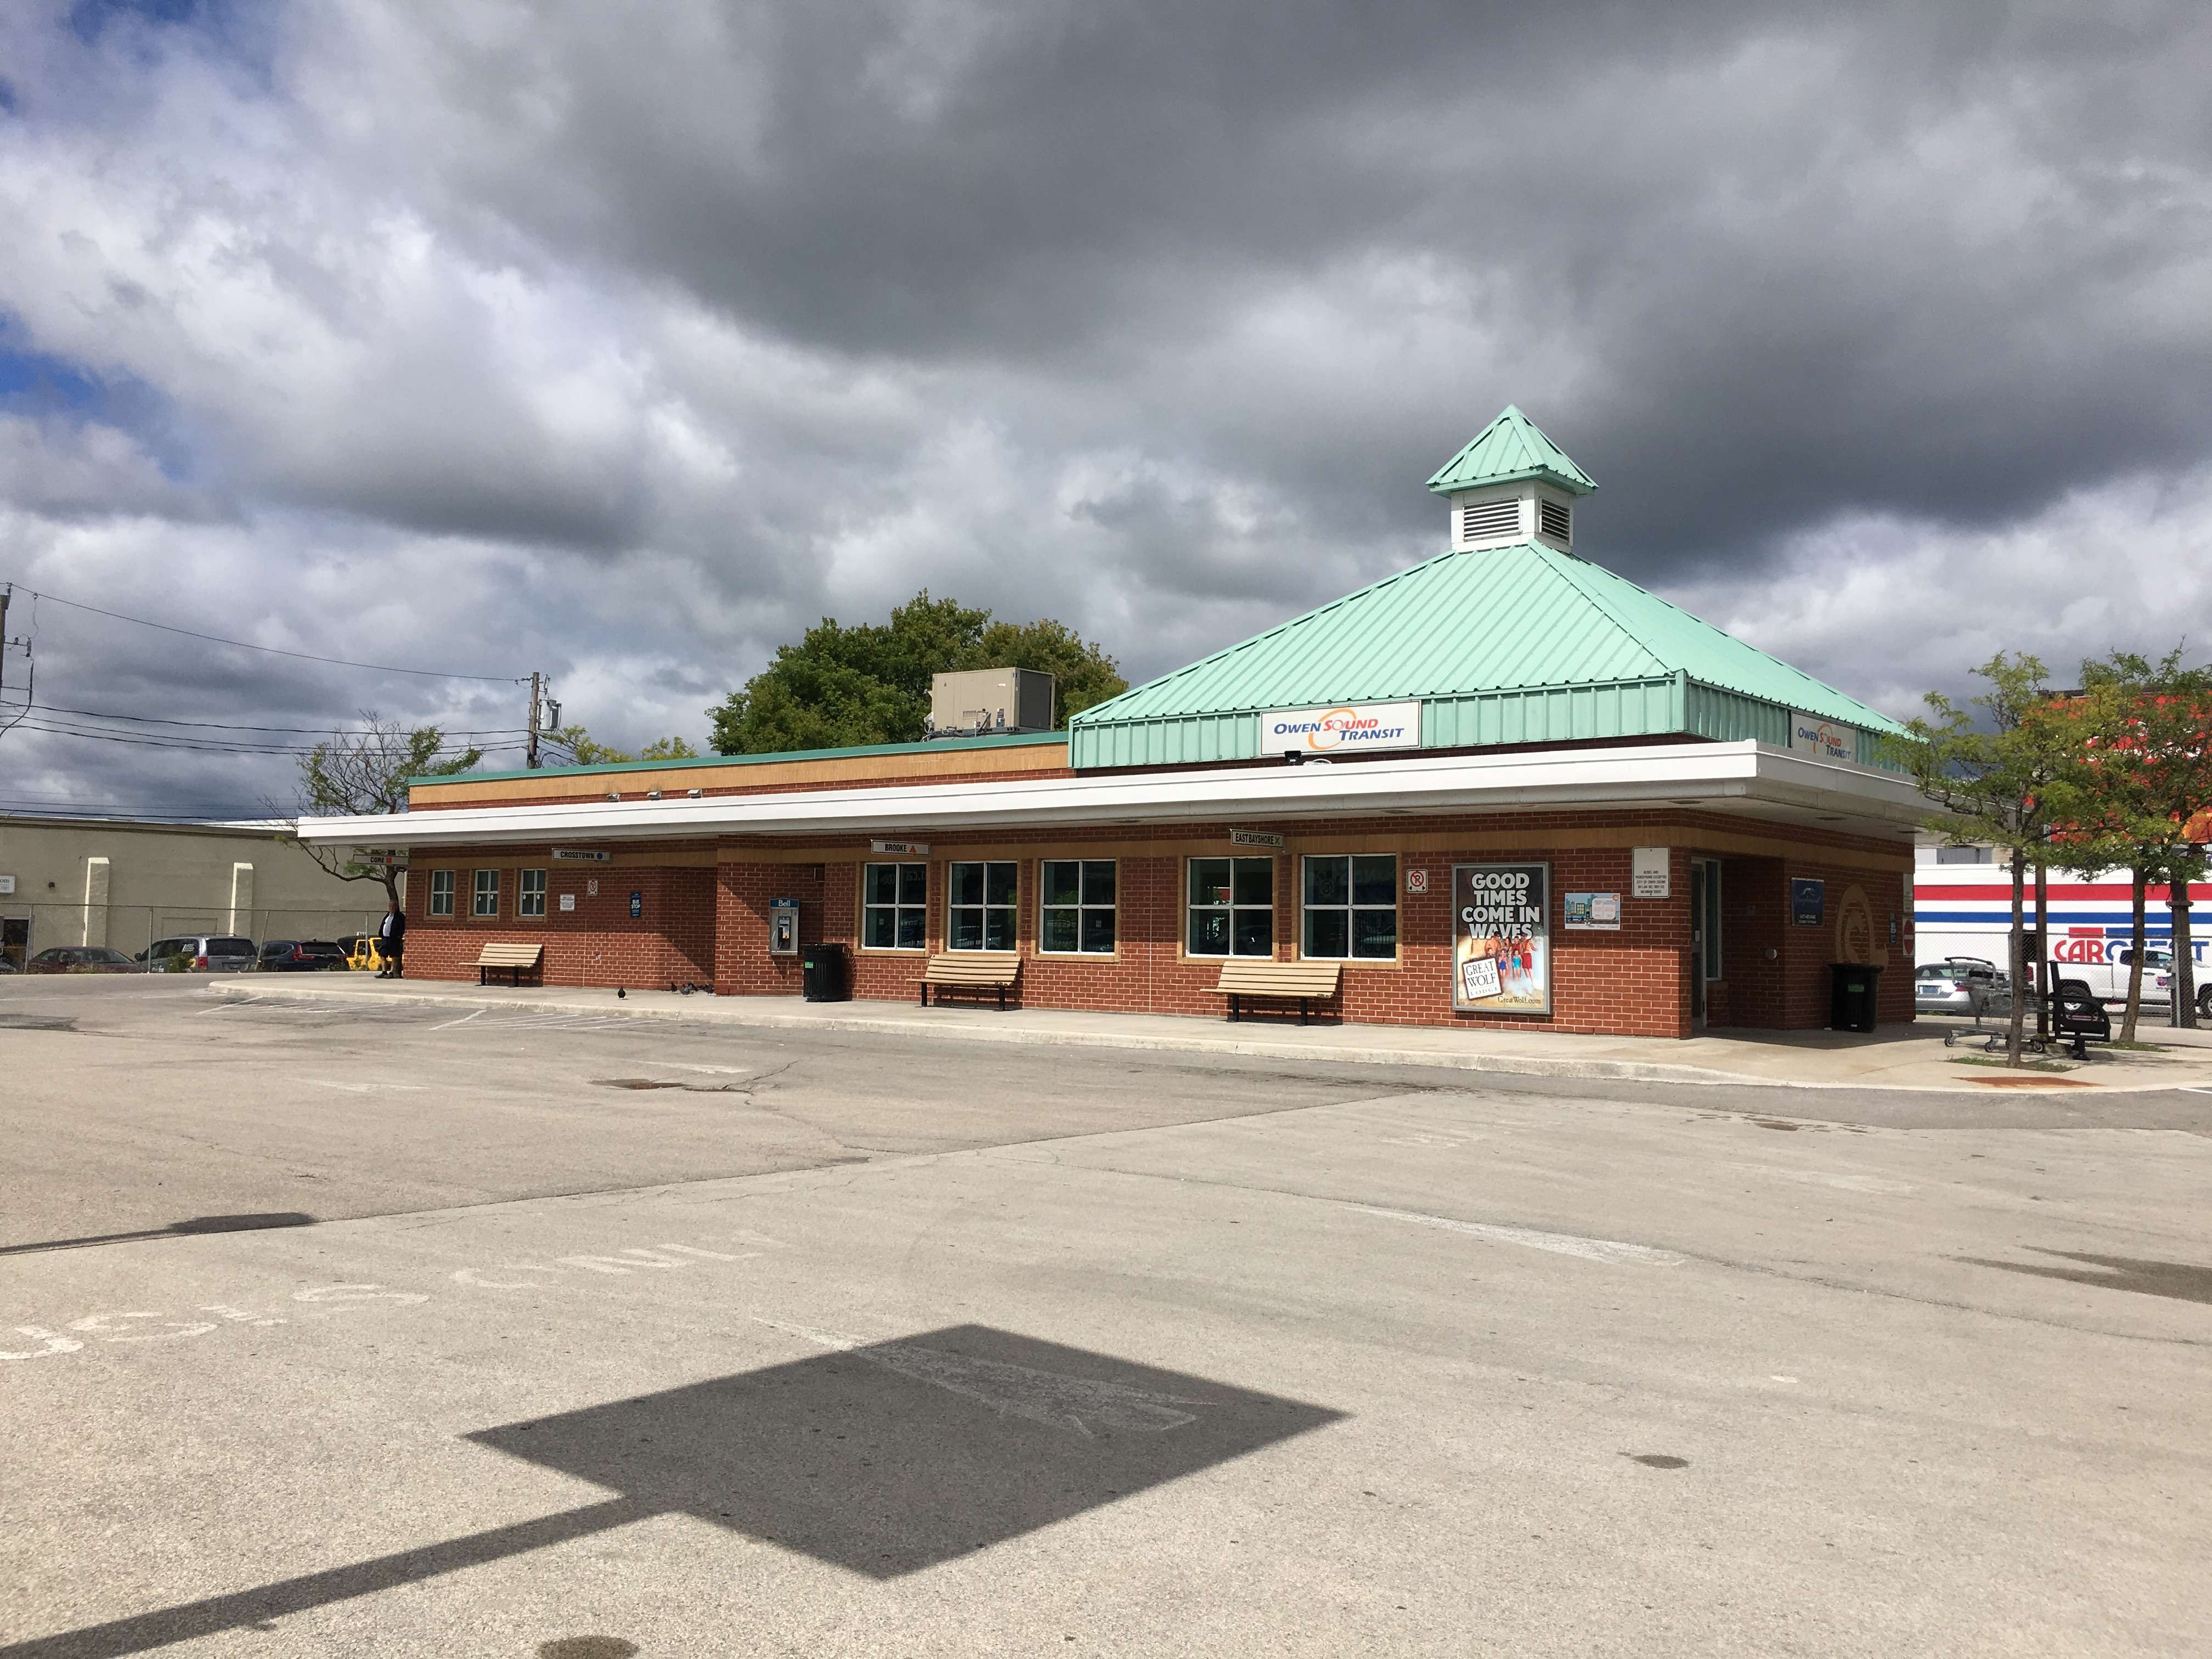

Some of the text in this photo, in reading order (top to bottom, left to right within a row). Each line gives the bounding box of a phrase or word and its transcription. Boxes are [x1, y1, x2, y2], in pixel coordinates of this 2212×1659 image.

[1273, 719, 1379, 734] OWEN SOUND
[1339, 728, 1404, 741] TRANSIT
[1798, 726, 1842, 747] OWEN SOUND
[1826, 744, 1851, 760] TRANSIT
[1235, 833, 1274, 845] EAST BAYSHORE
[560, 851, 595, 859] CROSSTOWN
[885, 844, 907, 852] BROOKE
[1471, 873, 1530, 889] GOOD
[1474, 890, 1527, 906] TIMES
[1462, 906, 1540, 923] COME IN
[1469, 923, 1532, 939] WAVES
[1466, 961, 1494, 976] GREAT
[1467, 973, 1497, 988] WOLF
[1498, 995, 1542, 1005] GreatWolf.com
